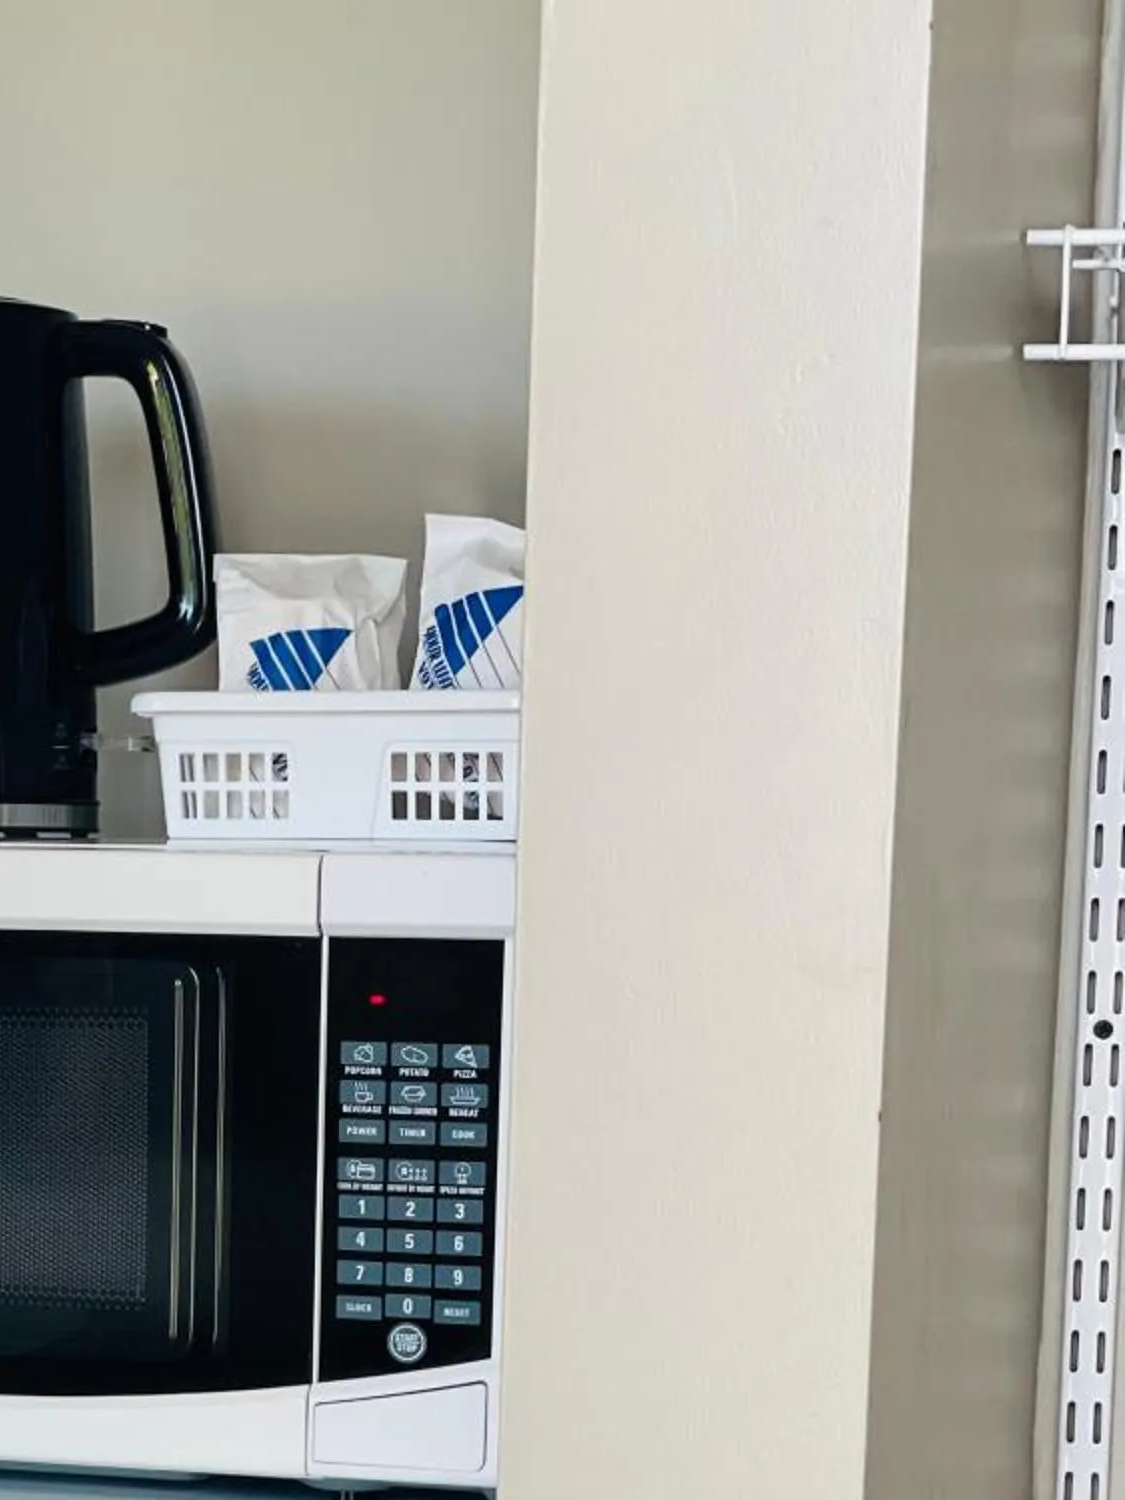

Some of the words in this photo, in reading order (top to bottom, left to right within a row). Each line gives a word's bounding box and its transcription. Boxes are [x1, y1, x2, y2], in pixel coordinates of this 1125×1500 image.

[344, 1066, 382, 1075] POPCORN
[399, 1067, 429, 1077] POTATO
[453, 1069, 477, 1078] PIZZA
[448, 1107, 479, 1117] REHEAT
[347, 1125, 377, 1136] POWER
[400, 1127, 425, 1138] TIMER
[452, 1129, 475, 1139] COOK
[358, 1199, 365, 1215] 1
[405, 1201, 415, 1217] 2
[455, 1203, 465, 1219] 3
[356, 1231, 365, 1247] 4
[405, 1233, 414, 1249] 5
[454, 1235, 464, 1252] 6
[356, 1265, 364, 1281] 7
[404, 1267, 413, 1283] 8
[453, 1269, 463, 1285] 9
[346, 1303, 372, 1313] CLOCK
[403, 1298, 412, 1315] 0
[443, 1307, 470, 1317] RESET
